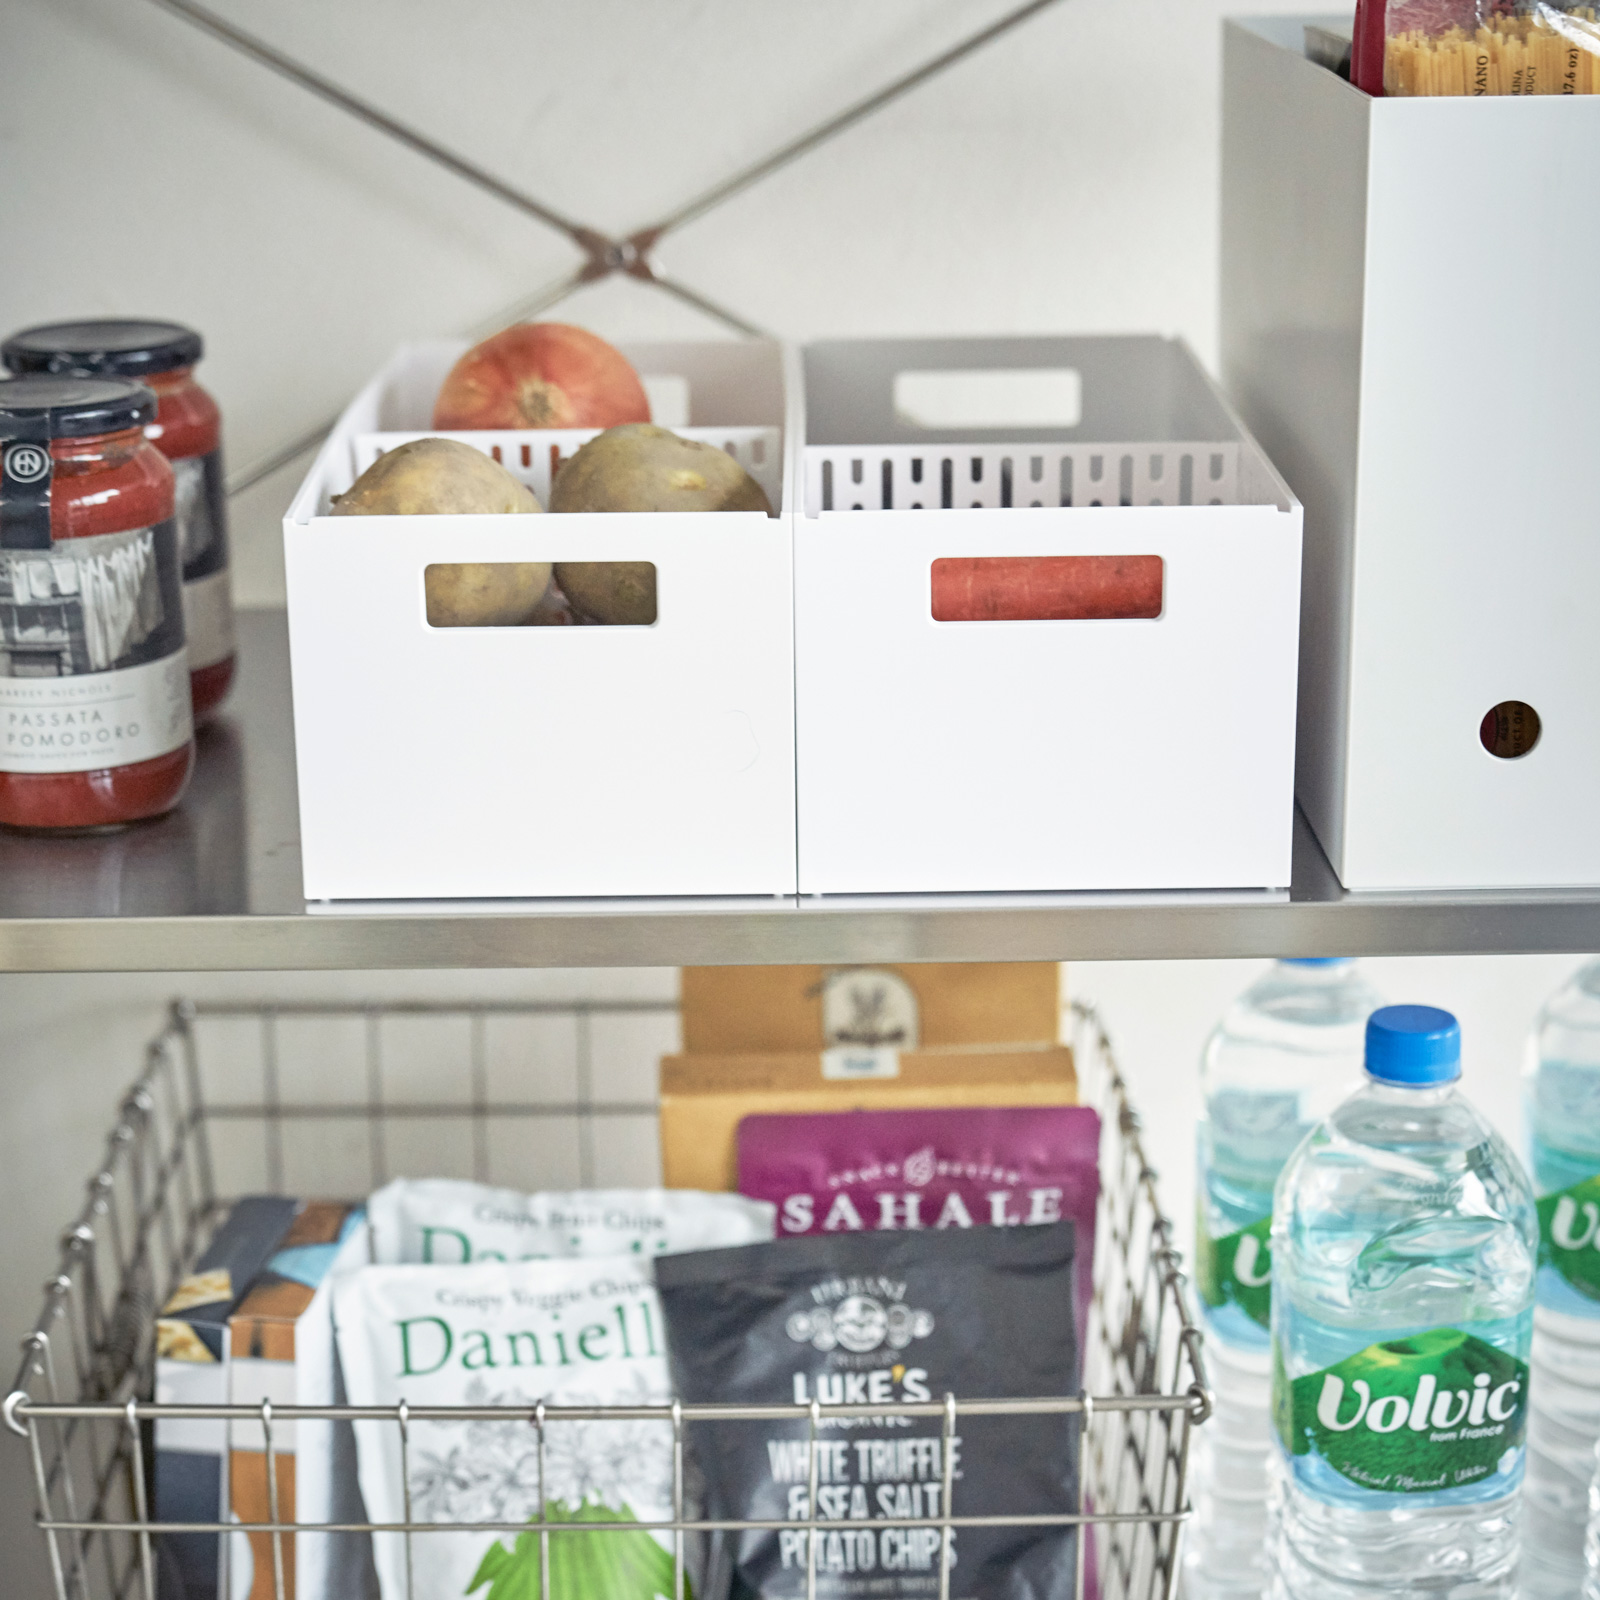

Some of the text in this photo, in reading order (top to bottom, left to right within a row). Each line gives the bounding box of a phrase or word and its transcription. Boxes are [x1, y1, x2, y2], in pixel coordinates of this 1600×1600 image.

[1511, 69, 1523, 96] LINA
[1525, 65, 1537, 96] DUCT
[8, 710, 103, 727] PASSATA
[7, 722, 140, 747] POMODORO
[781, 1187, 1064, 1233] SAHALE
[393, 1300, 664, 1379] Daniell
[792, 1364, 932, 1405] LUKE'S
[1316, 1372, 1521, 1434] Volvic
[1429, 1423, 1505, 1443] from France
